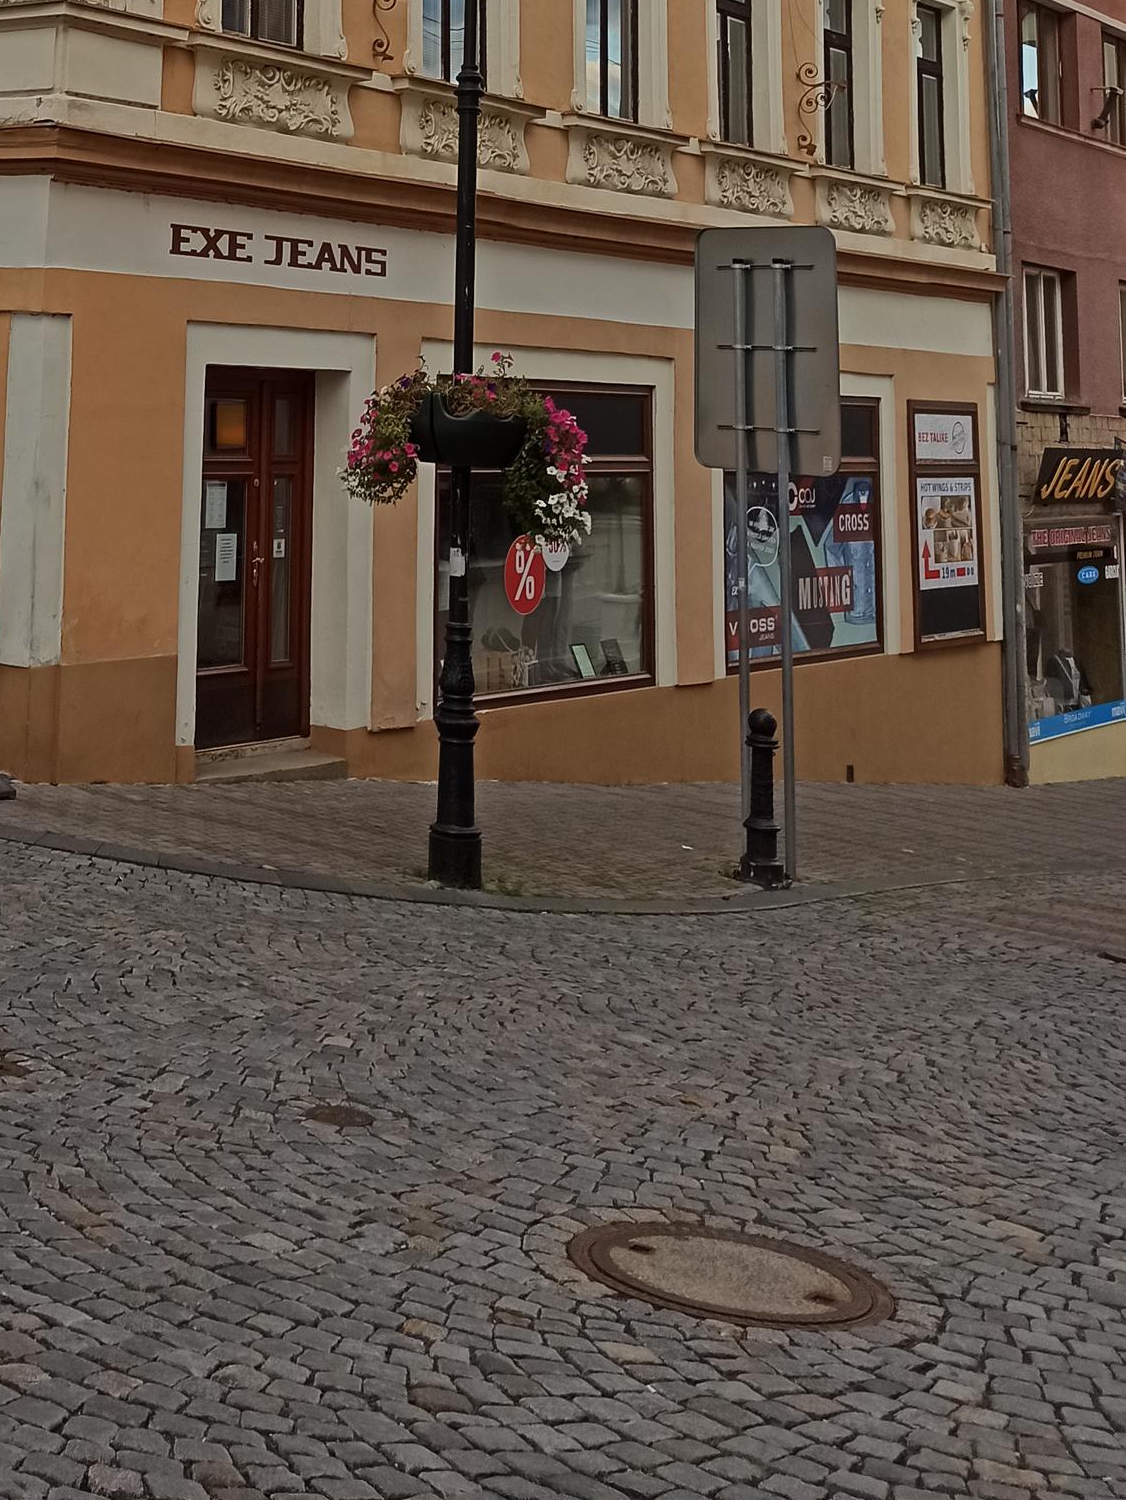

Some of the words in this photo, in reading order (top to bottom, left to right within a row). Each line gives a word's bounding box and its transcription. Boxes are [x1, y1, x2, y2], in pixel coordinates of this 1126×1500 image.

[169, 223, 253, 263] EXE
[264, 234, 387, 278] JEANS
[1041, 456, 1120, 500] JEANS
[838, 514, 869, 532] CROSS
[1049, 526, 1086, 546] ORIGINAL
[798, 574, 851, 610] MUSTANG
